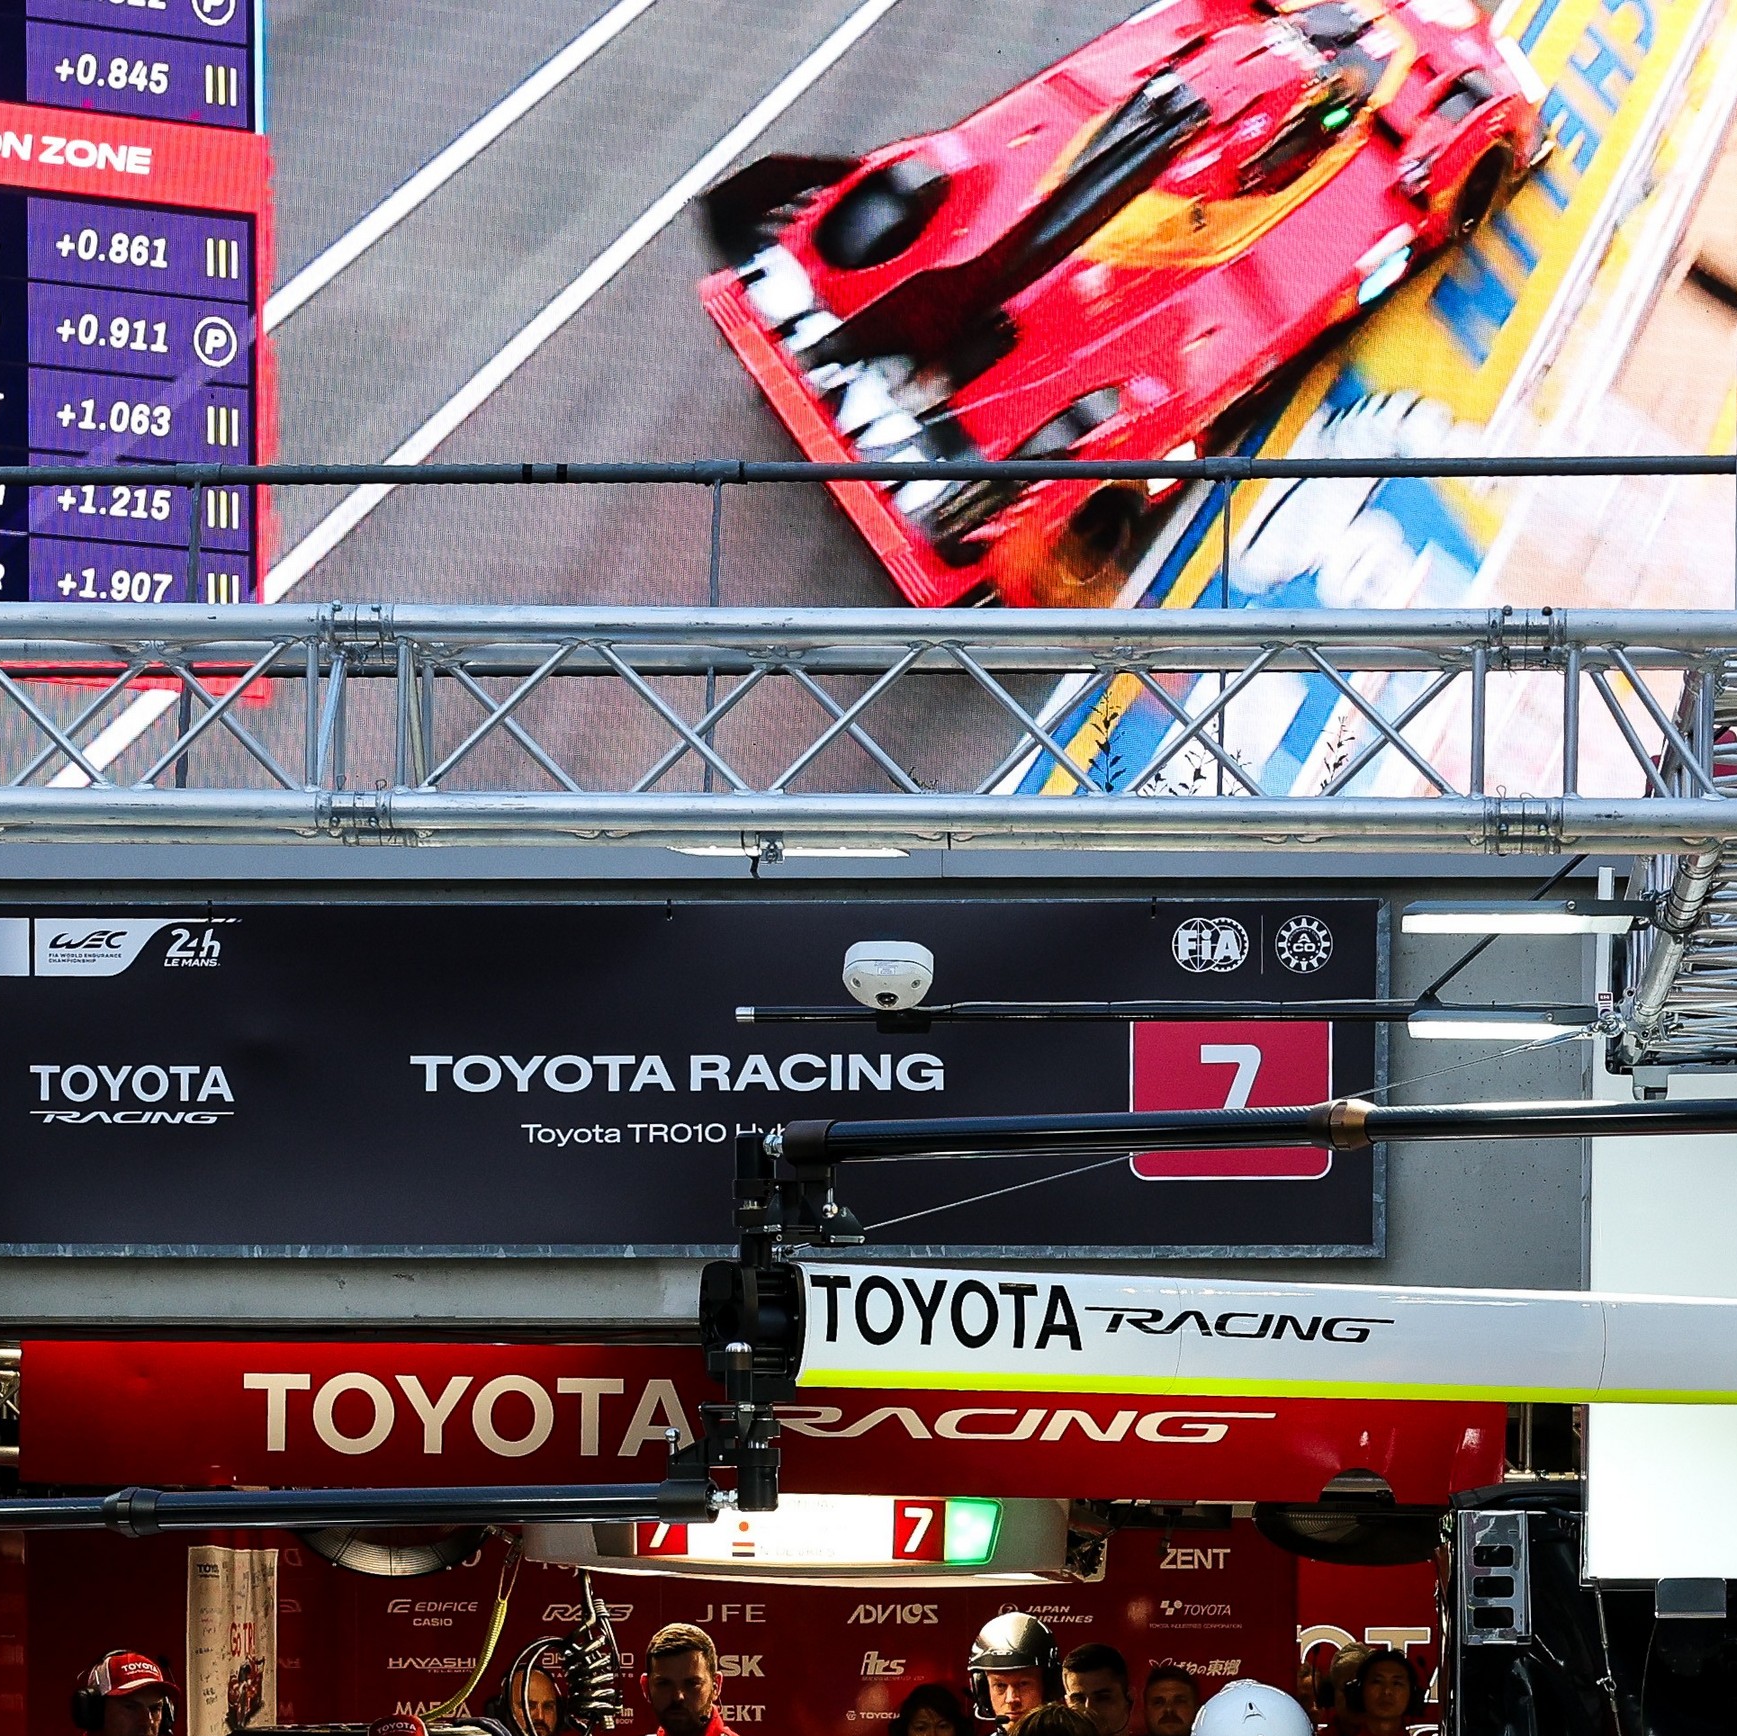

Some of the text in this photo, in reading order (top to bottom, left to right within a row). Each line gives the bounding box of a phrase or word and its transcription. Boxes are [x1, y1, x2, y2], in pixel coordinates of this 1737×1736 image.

[55, 53, 170, 96] +0.845
[40, 134, 152, 176] ZONE
[56, 230, 168, 269] +0.861
[56, 318, 168, 353] +0.911
[57, 402, 171, 438] +1.063
[57, 484, 170, 521] +1.215
[57, 569, 172, 604] +1.907
[48, 930, 128, 949] WEC
[166, 928, 221, 957] 24h
[181, 959, 217, 967] MANS
[30, 1064, 234, 1102] TOYOTA
[410, 1054, 945, 1092] TOYOTA RACING
[1200, 1044, 1263, 1111] 7
[30, 1110, 235, 1124] RACING
[521, 1123, 621, 1147] Toyota
[811, 1273, 1395, 1350] TOYOTA RACING
[243, 1372, 696, 1458] TOYOTA
[903, 1507, 933, 1553] 7
[1159, 1548, 1231, 1570] ZENT
[413, 1618, 453, 1626] CASIO
[415, 1602, 478, 1612] EDIFICE
[696, 1604, 766, 1623] JFE
[1184, 1604, 1231, 1616] TOYOTA
